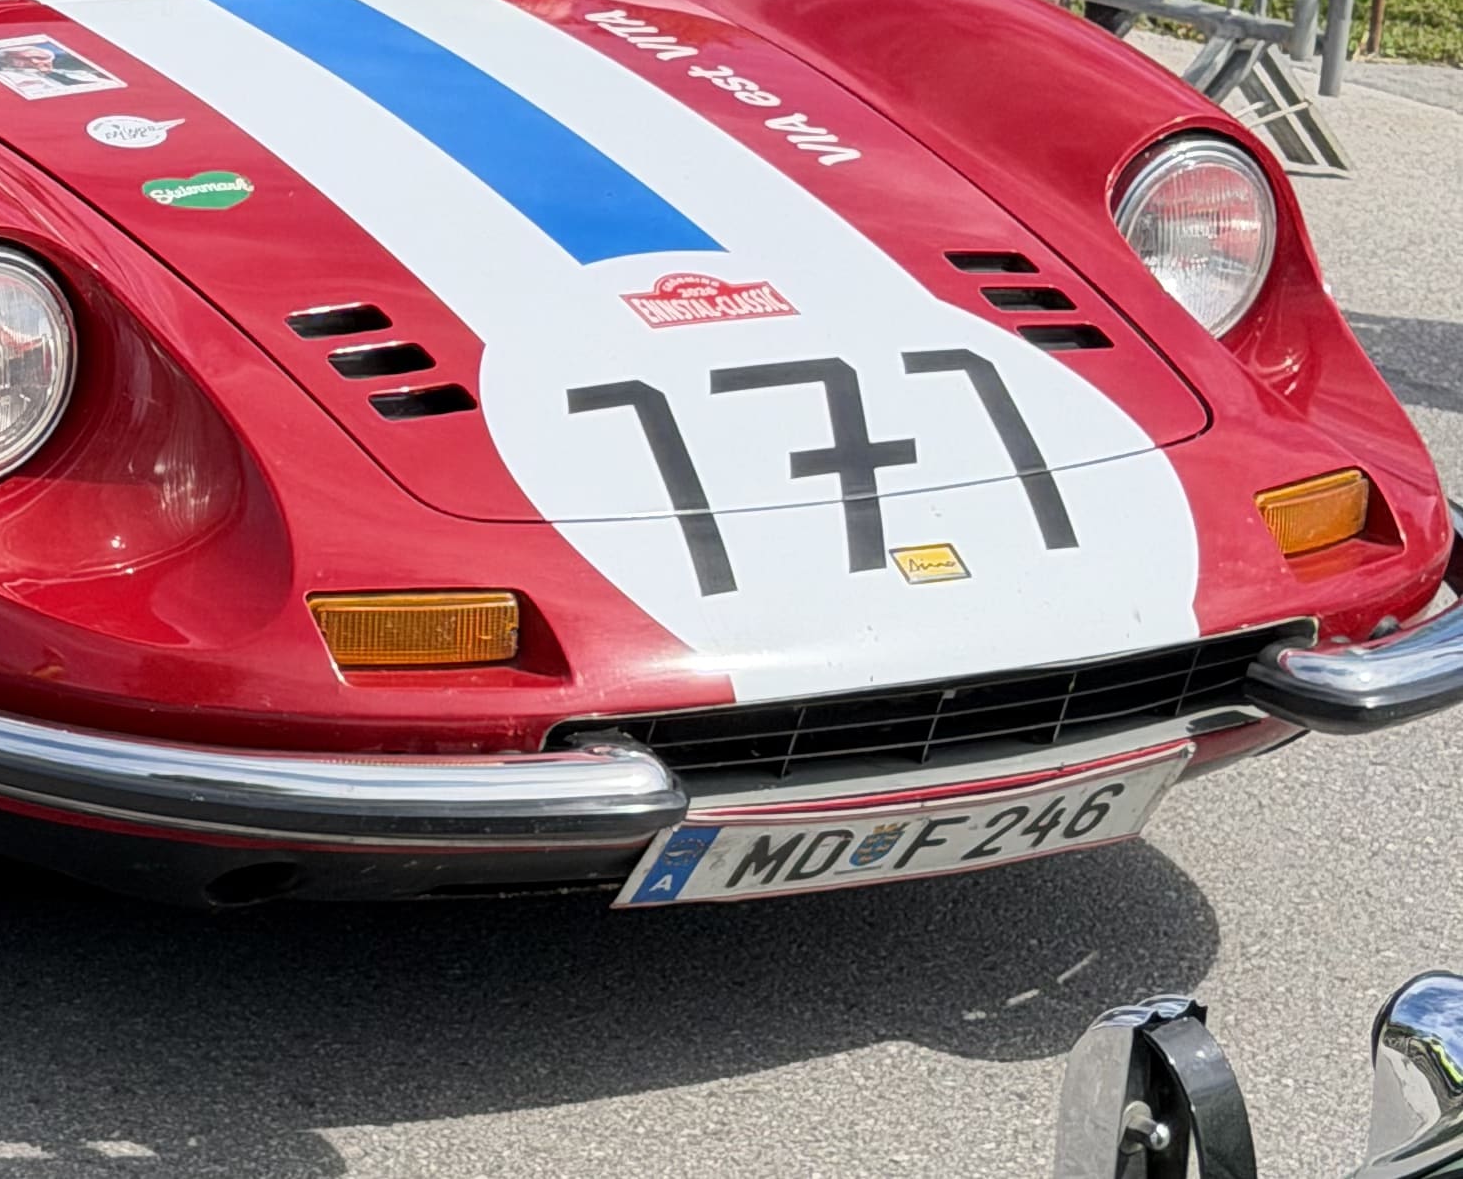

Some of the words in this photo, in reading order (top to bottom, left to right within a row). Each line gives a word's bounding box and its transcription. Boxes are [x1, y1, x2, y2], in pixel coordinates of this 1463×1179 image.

[585, 9, 699, 61] VITA
[687, 65, 782, 107] est
[764, 113, 862, 166] VIA
[150, 178, 255, 205] Steiermark
[631, 285, 790, 324] ENNSTAL-CLASSIC
[567, 348, 1079, 596] 171
[726, 828, 855, 888] MD
[893, 815, 971, 869] F
[960, 783, 1126, 861] 246
[649, 873, 673, 893] A
